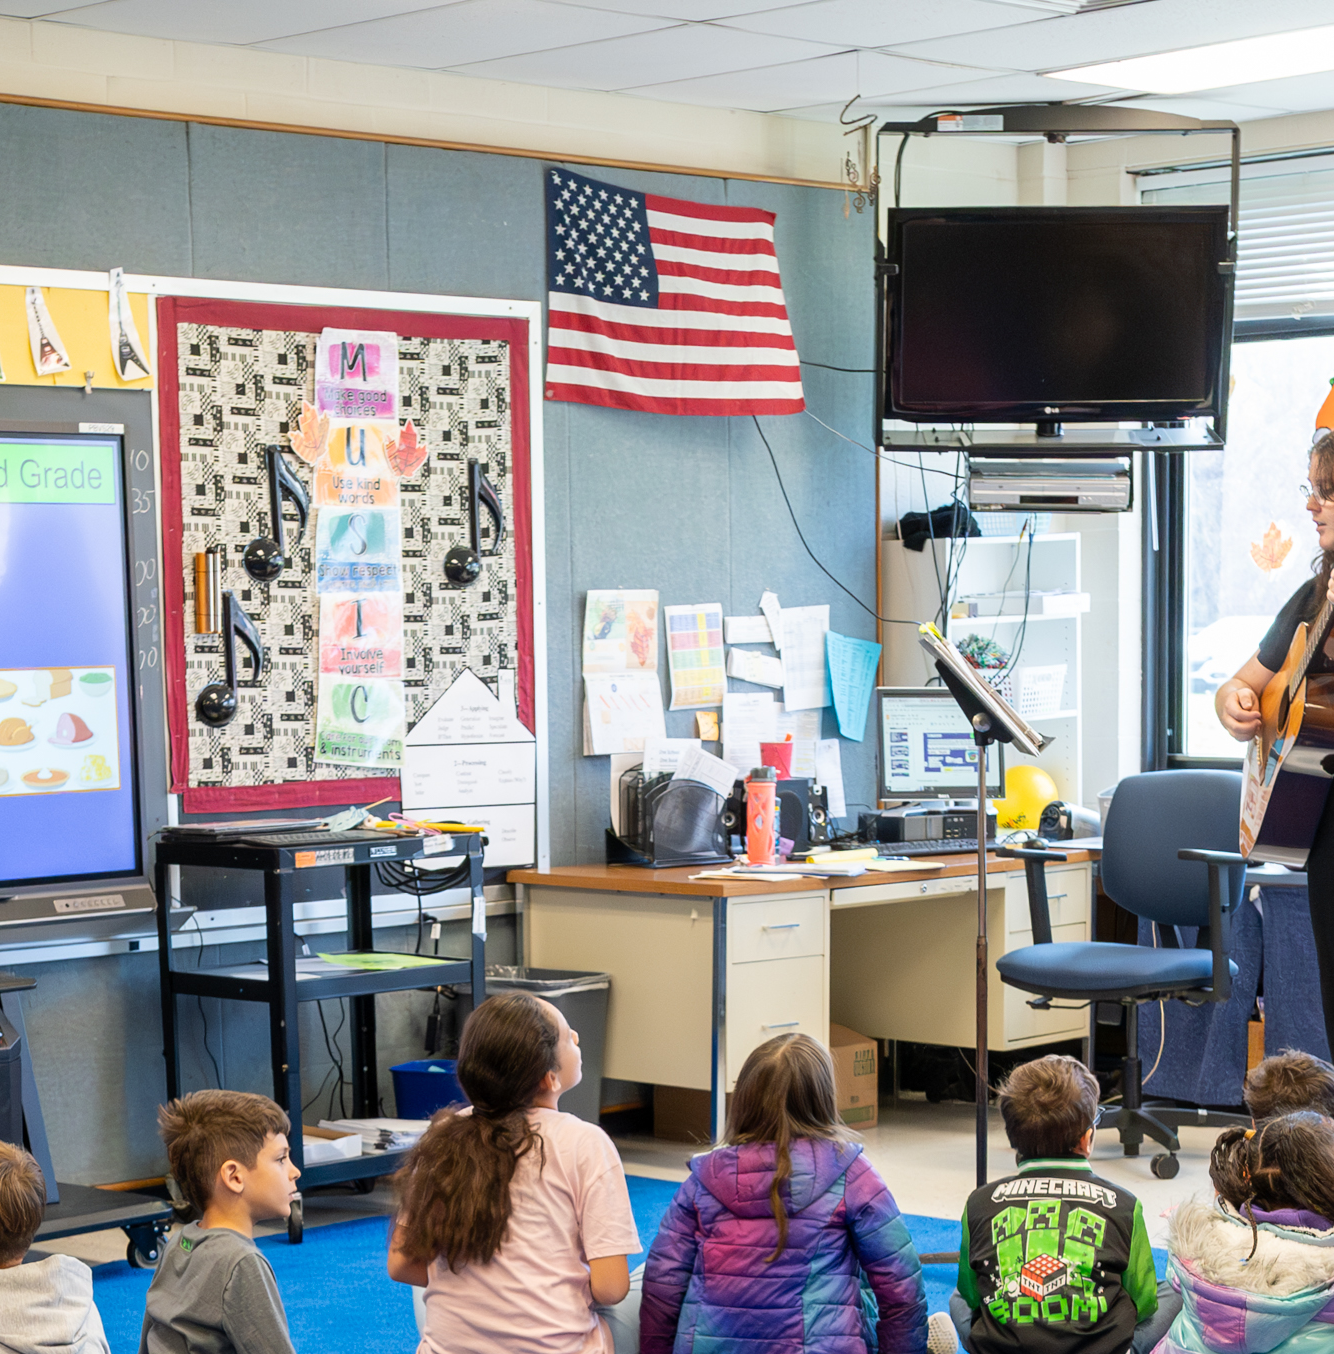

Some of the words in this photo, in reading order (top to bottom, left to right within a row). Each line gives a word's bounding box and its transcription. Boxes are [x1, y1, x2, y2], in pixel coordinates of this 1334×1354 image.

[340, 341, 367, 382] M
[324, 388, 356, 404] Make
[358, 389, 387, 405] good
[334, 401, 377, 416] choices
[345, 427, 366, 468] U
[19, 459, 103, 490] Grade
[331, 476, 354, 491] Use
[356, 476, 381, 491] kind
[337, 491, 375, 505] words
[348, 514, 368, 556] S
[318, 563, 350, 577] Show
[352, 563, 398, 580] respect
[351, 597, 367, 640] I
[340, 648, 383, 660] Involve
[339, 661, 384, 675] yourself
[350, 686, 370, 723] C
[320, 743, 327, 754] &
[991, 1177, 1117, 1209] MINECRAFT
[1022, 1277, 1041, 1293] TNT
[1044, 1274, 1066, 1293] TNT
